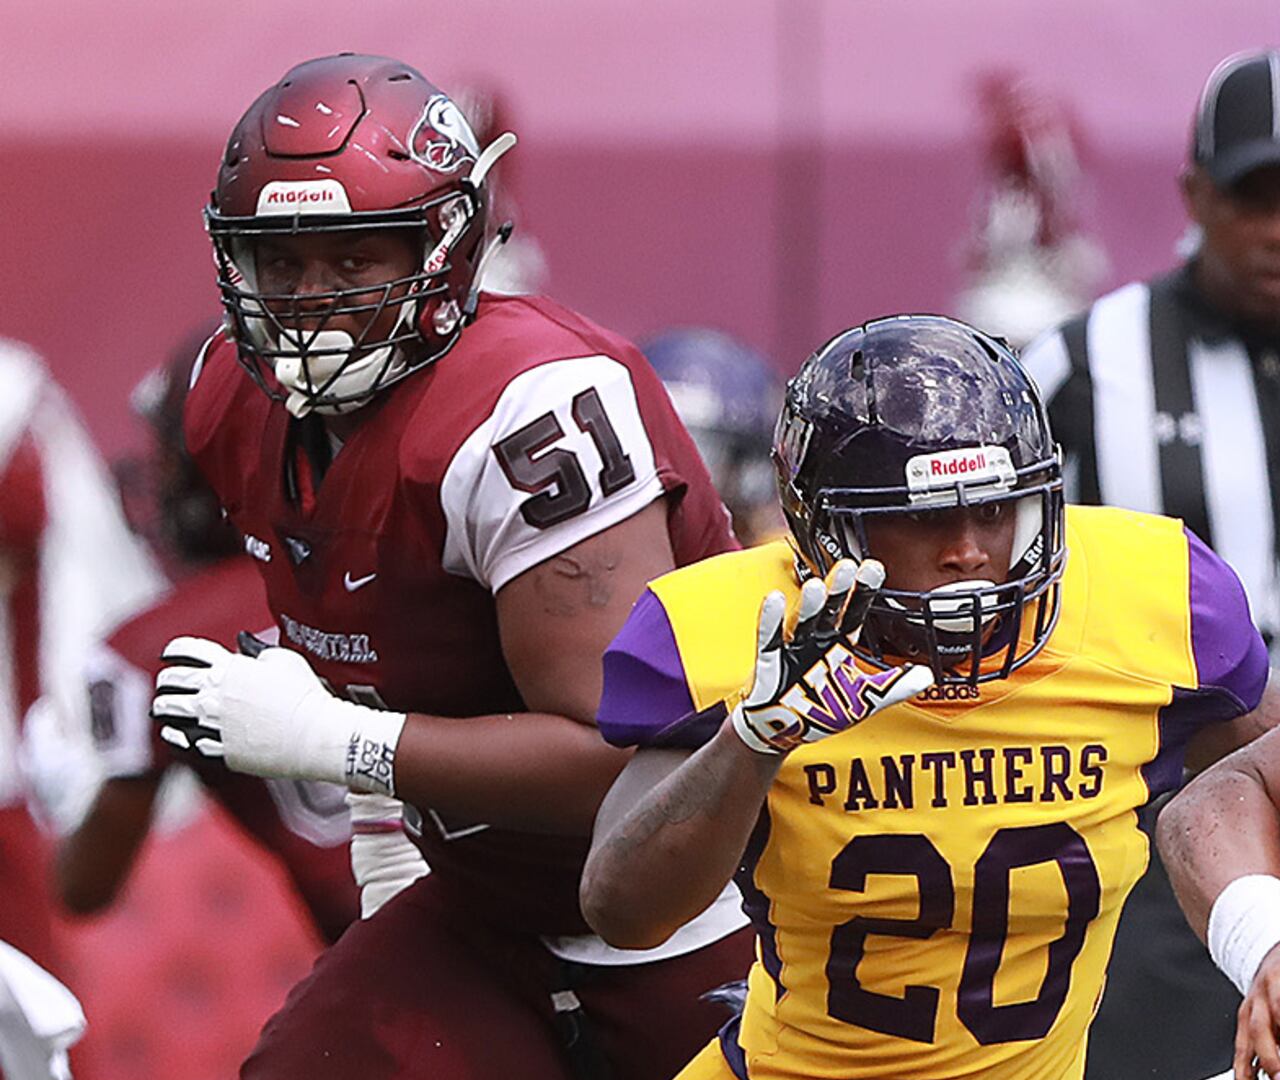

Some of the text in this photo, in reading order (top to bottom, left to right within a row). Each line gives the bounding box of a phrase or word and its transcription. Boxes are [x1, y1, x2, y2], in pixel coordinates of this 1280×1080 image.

[491, 386, 636, 530] 51
[930, 453, 987, 477] Riddell
[803, 744, 1107, 812] PANTHERS
[824, 821, 1101, 1046] 20
